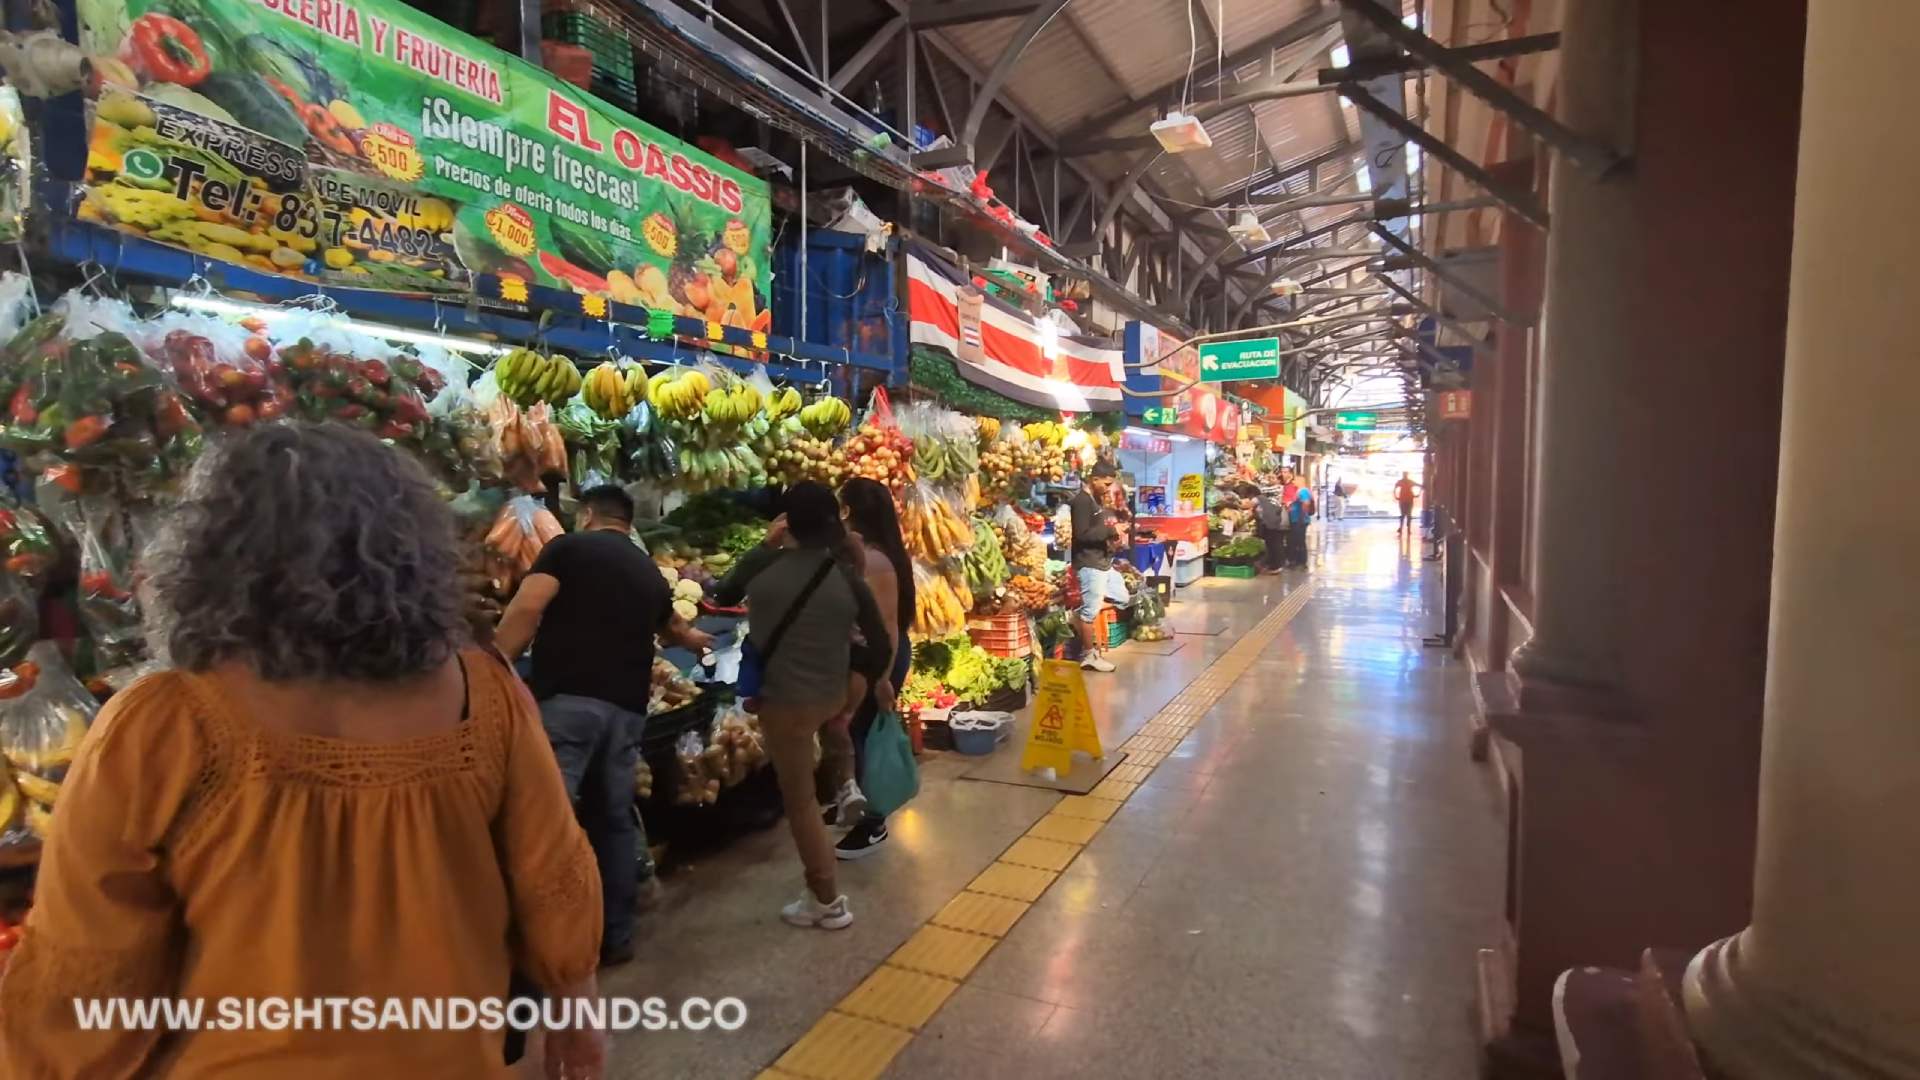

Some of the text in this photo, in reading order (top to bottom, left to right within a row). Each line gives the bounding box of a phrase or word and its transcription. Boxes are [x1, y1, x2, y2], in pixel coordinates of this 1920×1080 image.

[369, 17, 388, 54] Y
[395, 29, 502, 103] FRUTERÍA
[155, 113, 300, 182] EXPRESS
[547, 90, 743, 213] EL OASSIS
[552, 144, 640, 212] frescas!
[168, 156, 262, 222] Tel:
[435, 155, 491, 192] Precios
[494, 175, 512, 198] de
[514, 184, 553, 213] oferta
[554, 197, 589, 226] todos
[590, 210, 609, 233] los
[1239, 349, 1276, 360] RUTA DE
